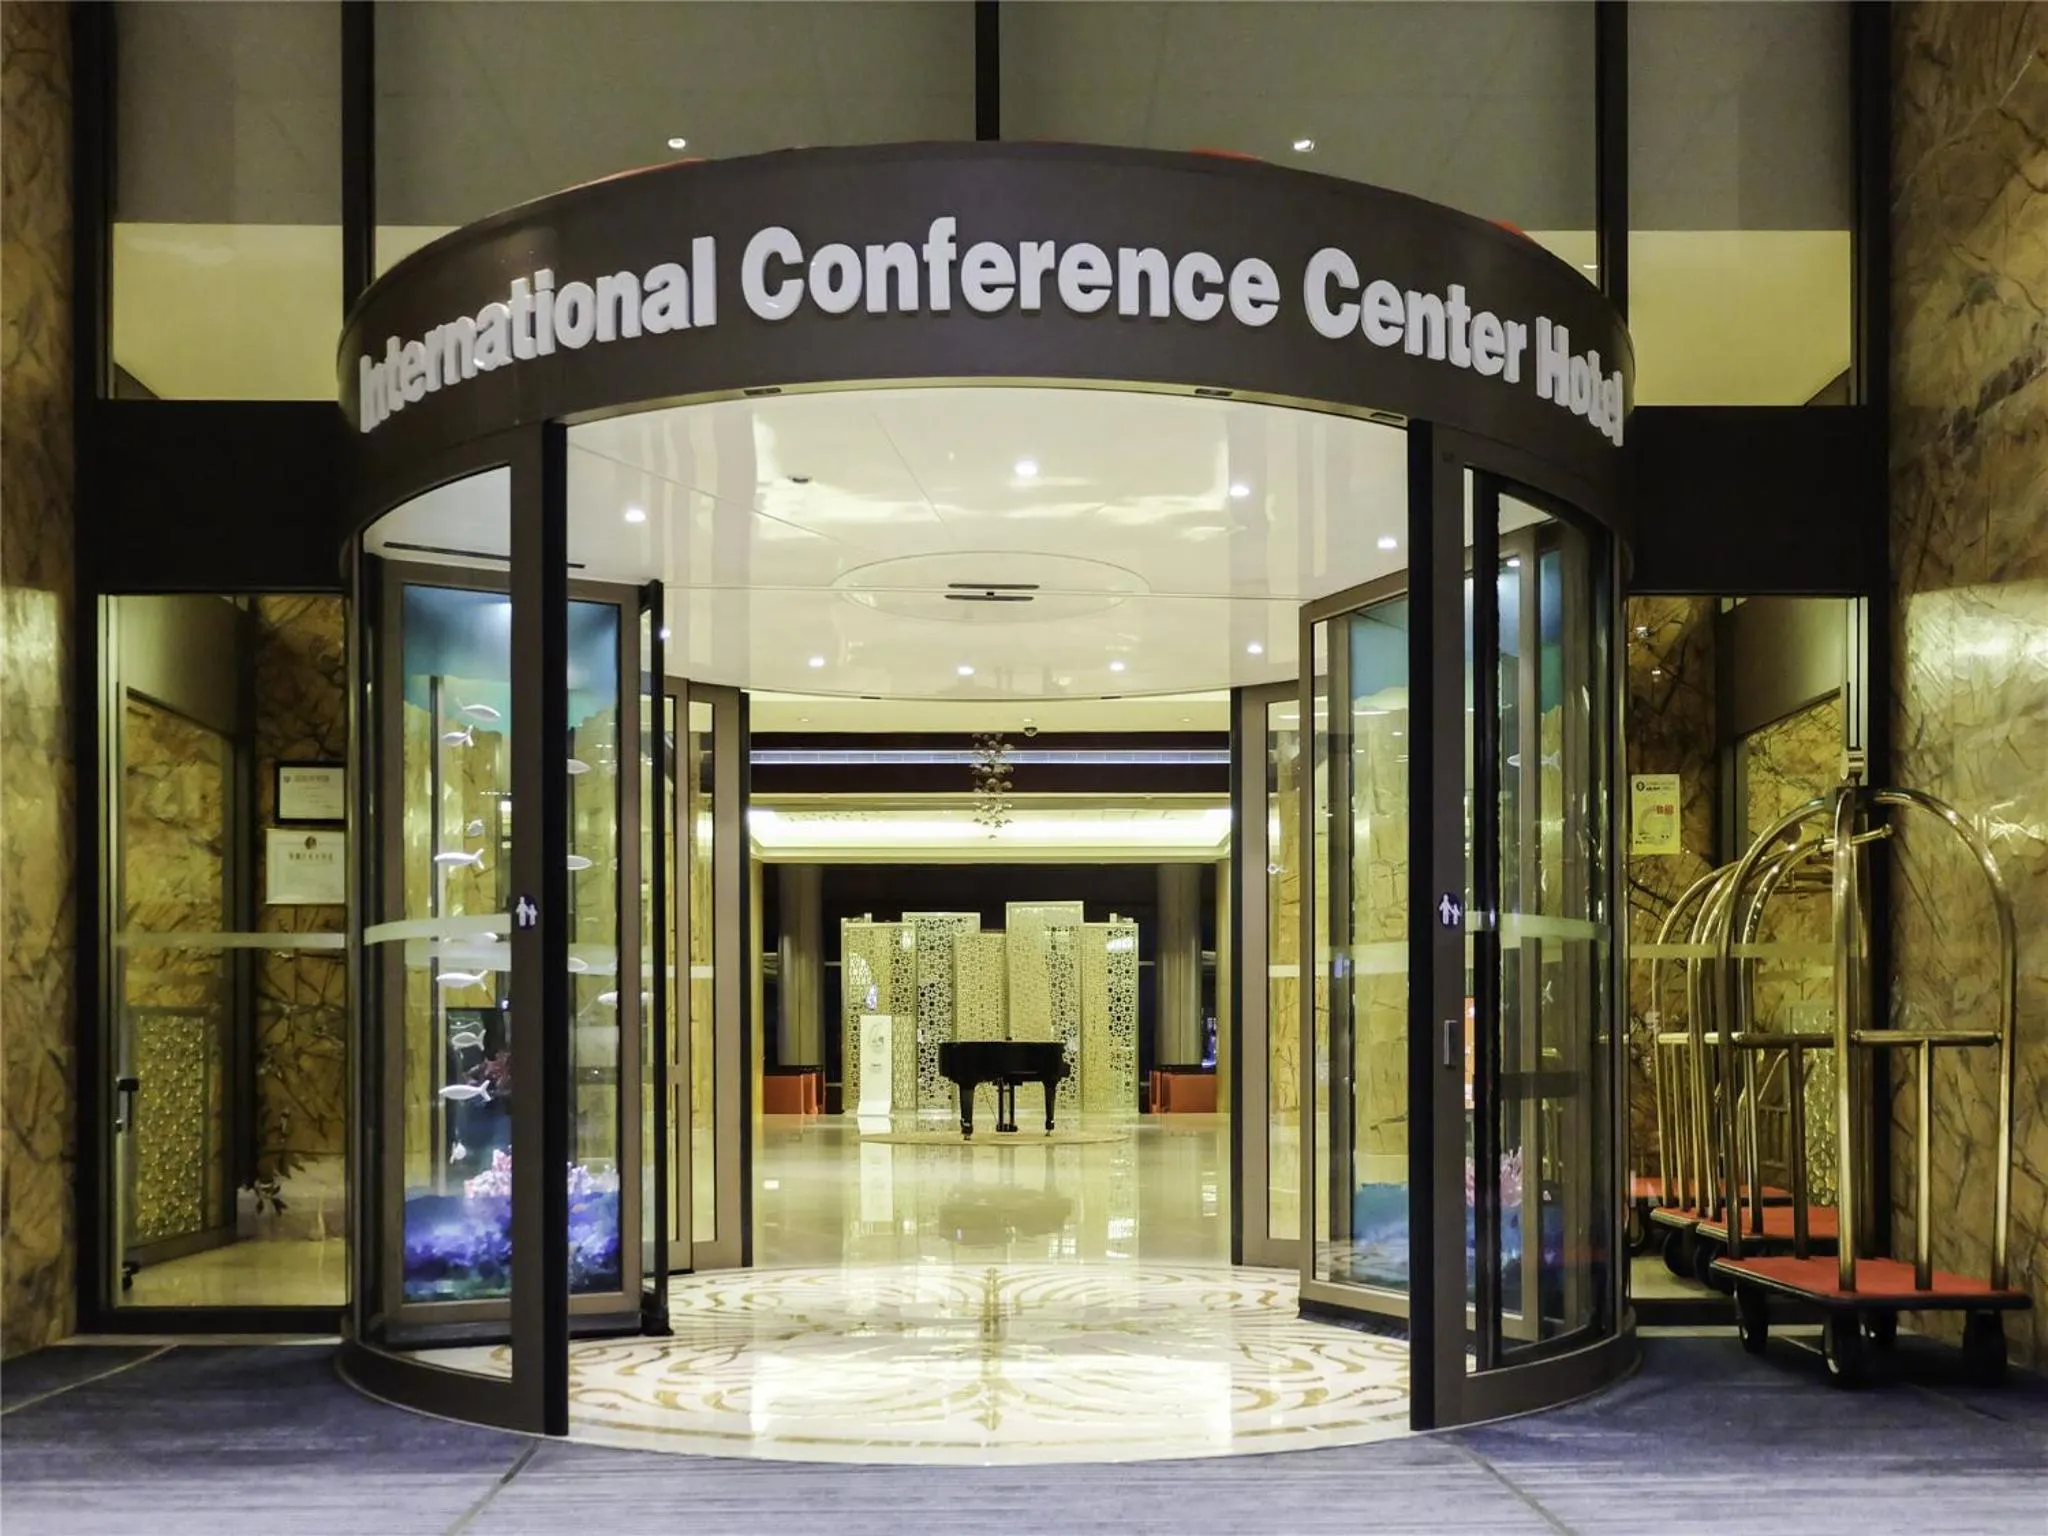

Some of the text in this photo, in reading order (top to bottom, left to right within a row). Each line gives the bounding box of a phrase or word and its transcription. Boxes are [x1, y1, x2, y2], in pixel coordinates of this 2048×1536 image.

[359, 216, 1623, 447] International Conference Center Hotel
